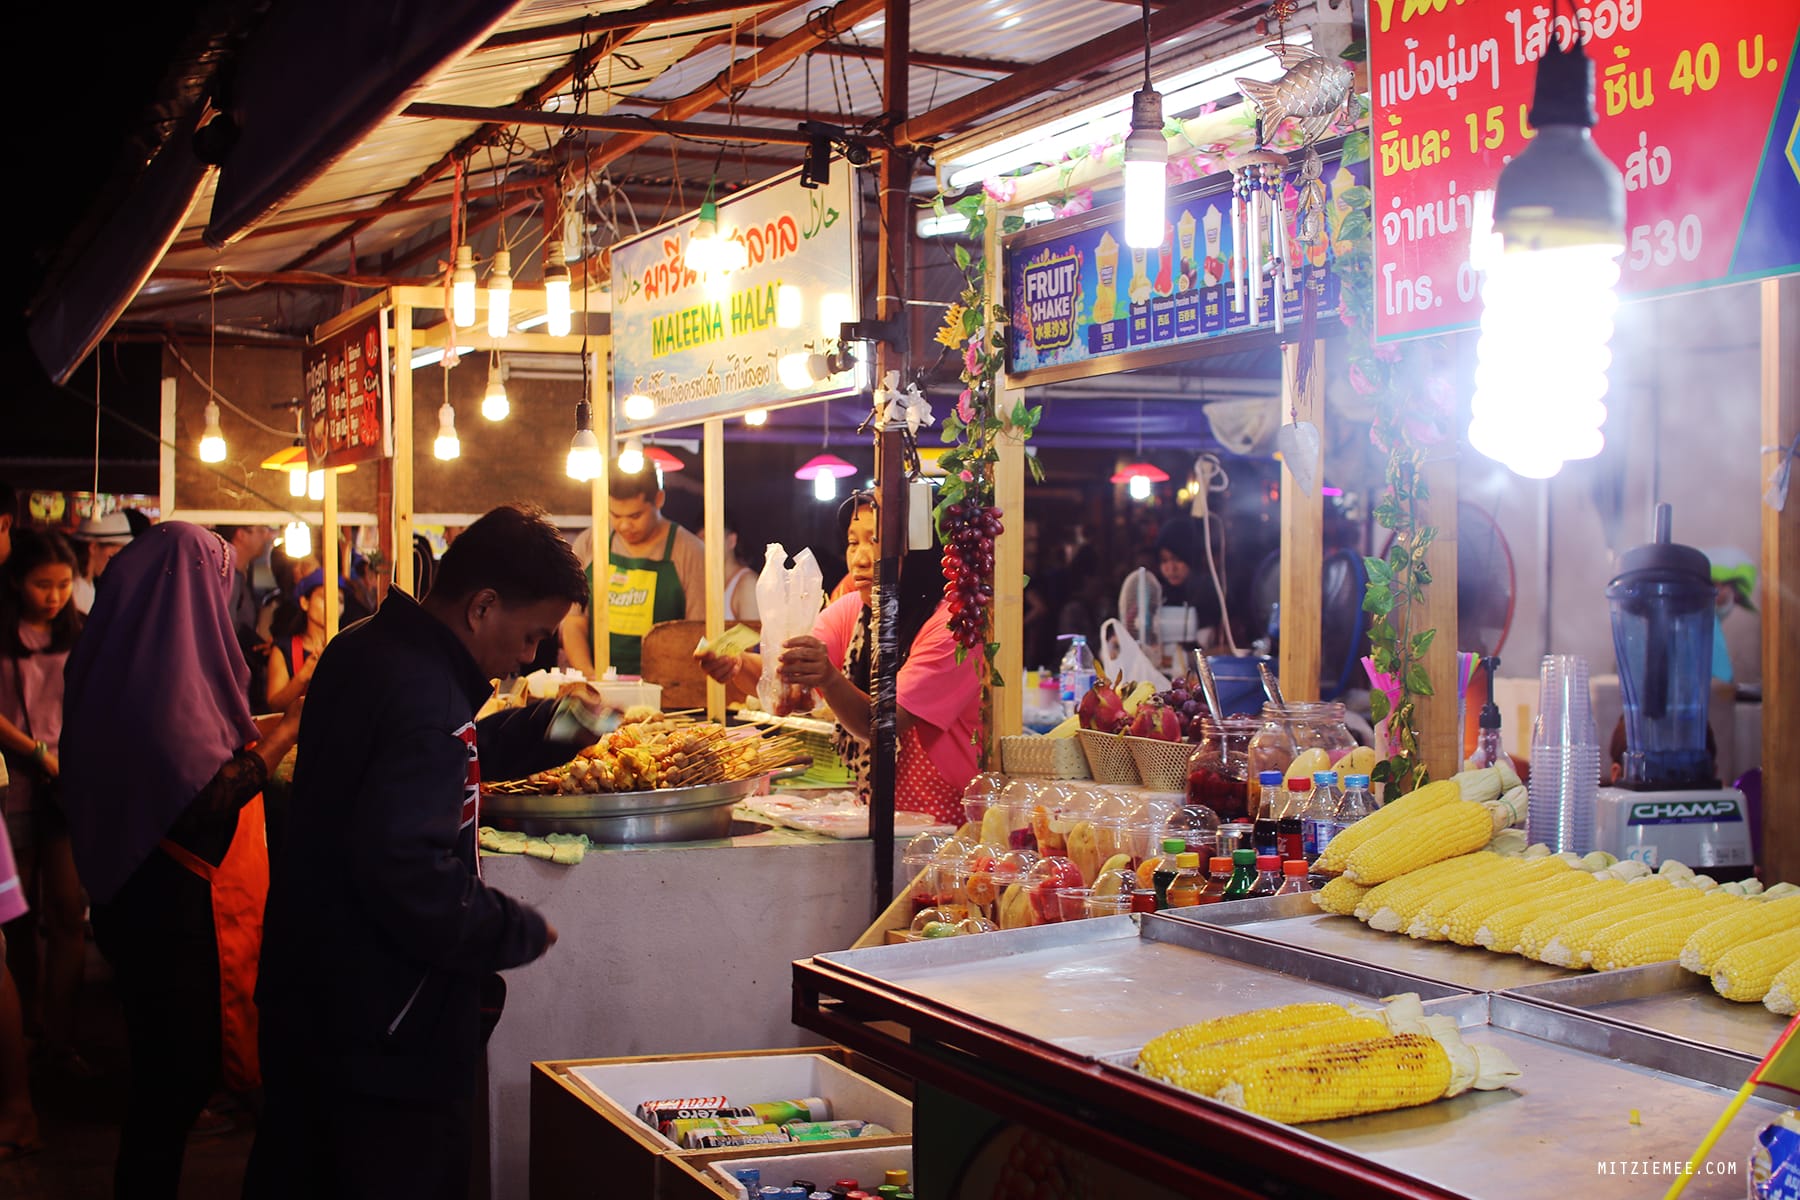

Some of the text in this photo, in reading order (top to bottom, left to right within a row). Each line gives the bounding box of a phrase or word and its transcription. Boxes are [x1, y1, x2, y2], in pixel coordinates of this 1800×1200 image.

[1505, 0, 1643, 65] ไส้อรอย
[1669, 42, 1720, 96] 40
[1465, 106, 1505, 154] 15
[1382, 180, 1473, 246] จำหน่า
[1027, 264, 1075, 302] FRUIT
[1032, 296, 1070, 322] SHAKE
[1383, 262, 1442, 316] โทร.
[652, 280, 784, 357] MALEENA HALA
[1634, 802, 1735, 818] CHAMP
